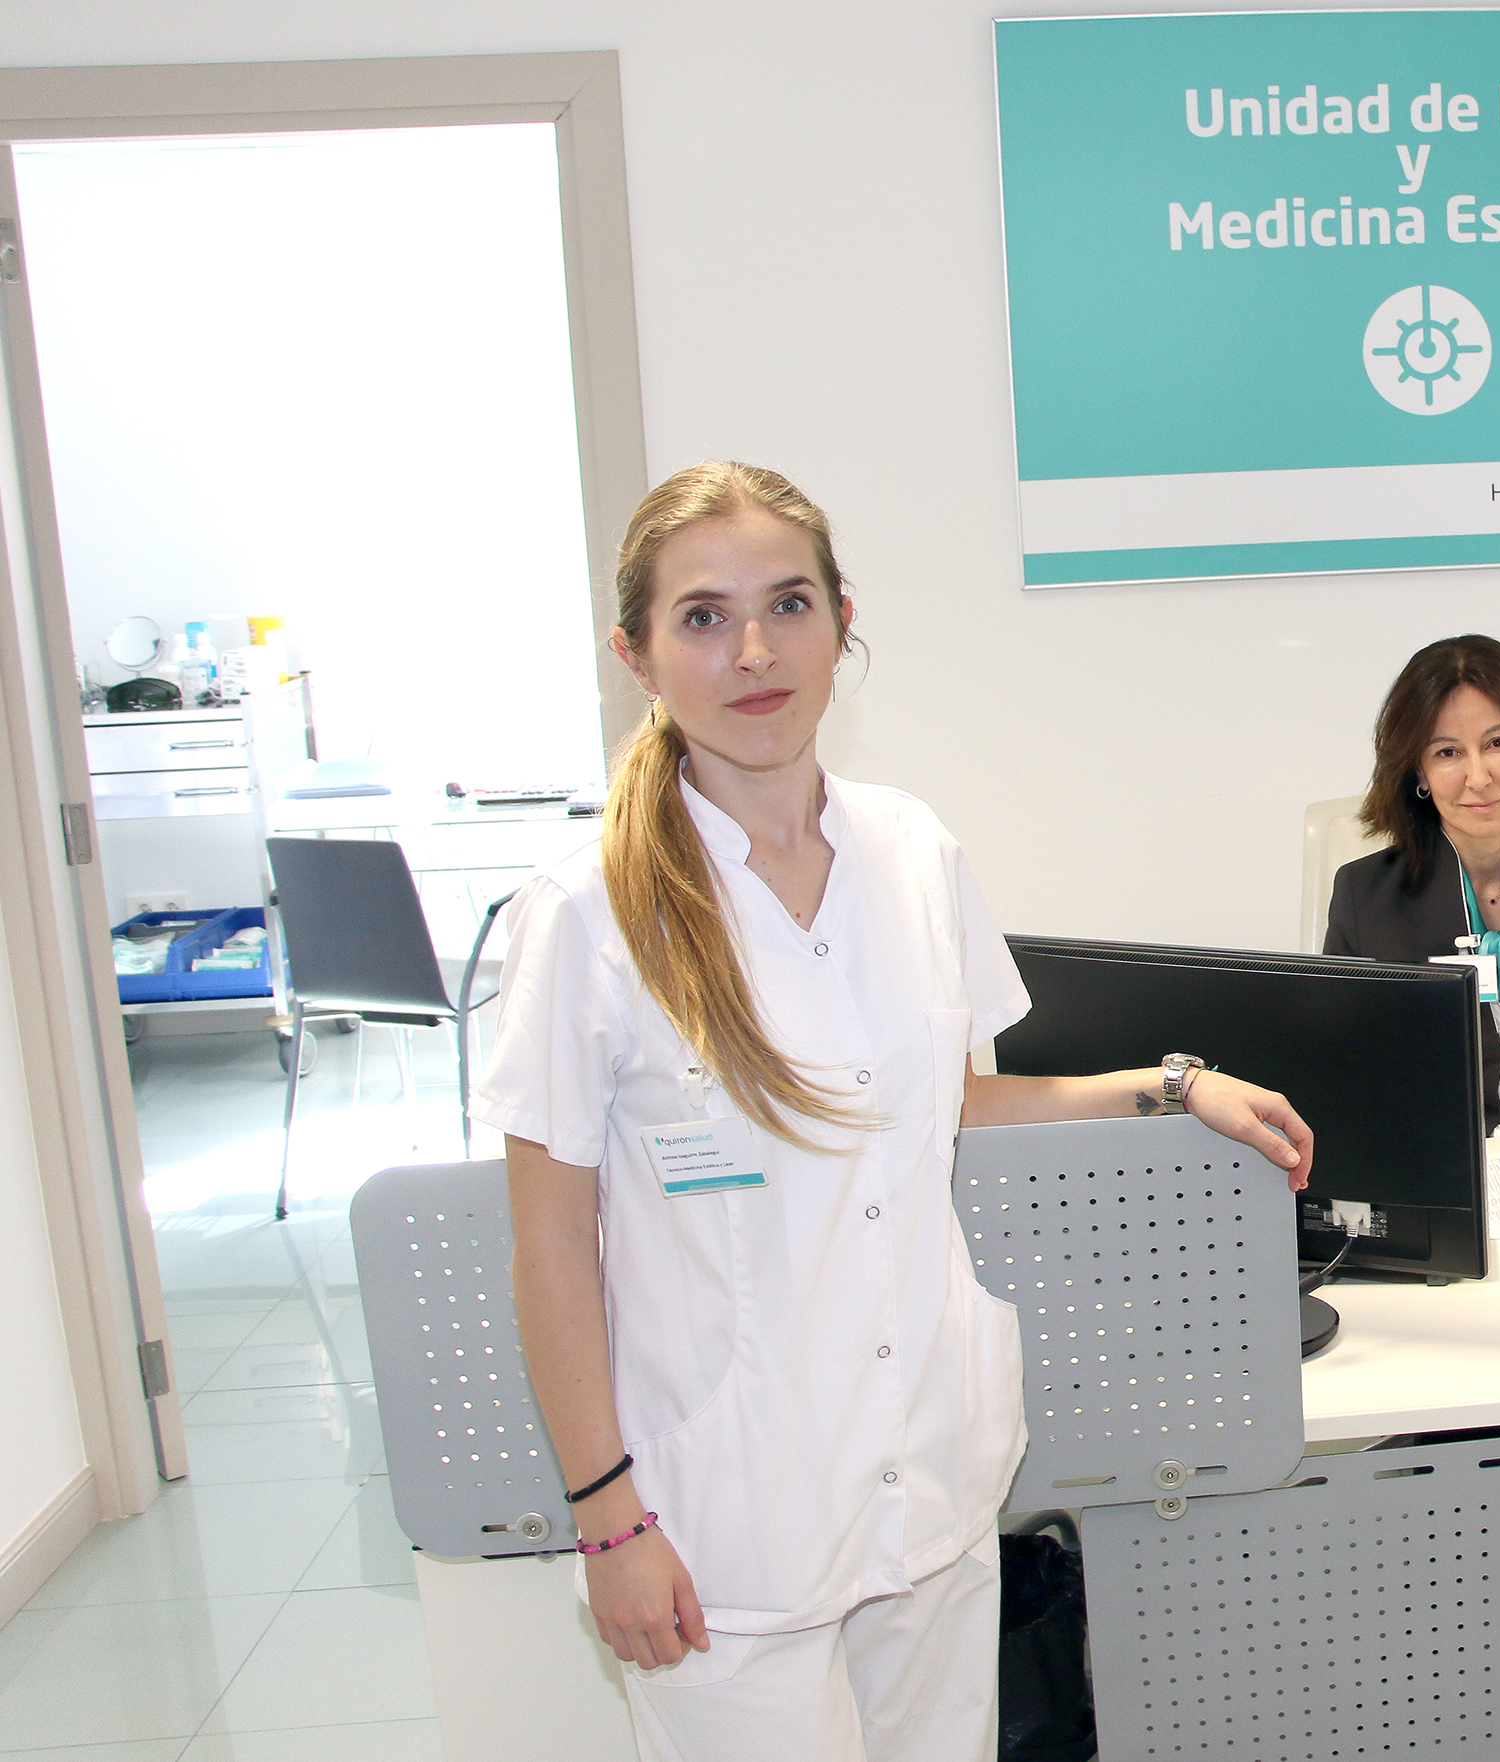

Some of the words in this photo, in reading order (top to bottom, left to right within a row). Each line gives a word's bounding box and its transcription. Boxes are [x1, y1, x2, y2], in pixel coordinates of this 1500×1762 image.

[1185, 83, 1390, 138] Unidad
[1410, 82, 1480, 133] de
[1395, 143, 1431, 194] y
[1168, 195, 1426, 251] Medicina
